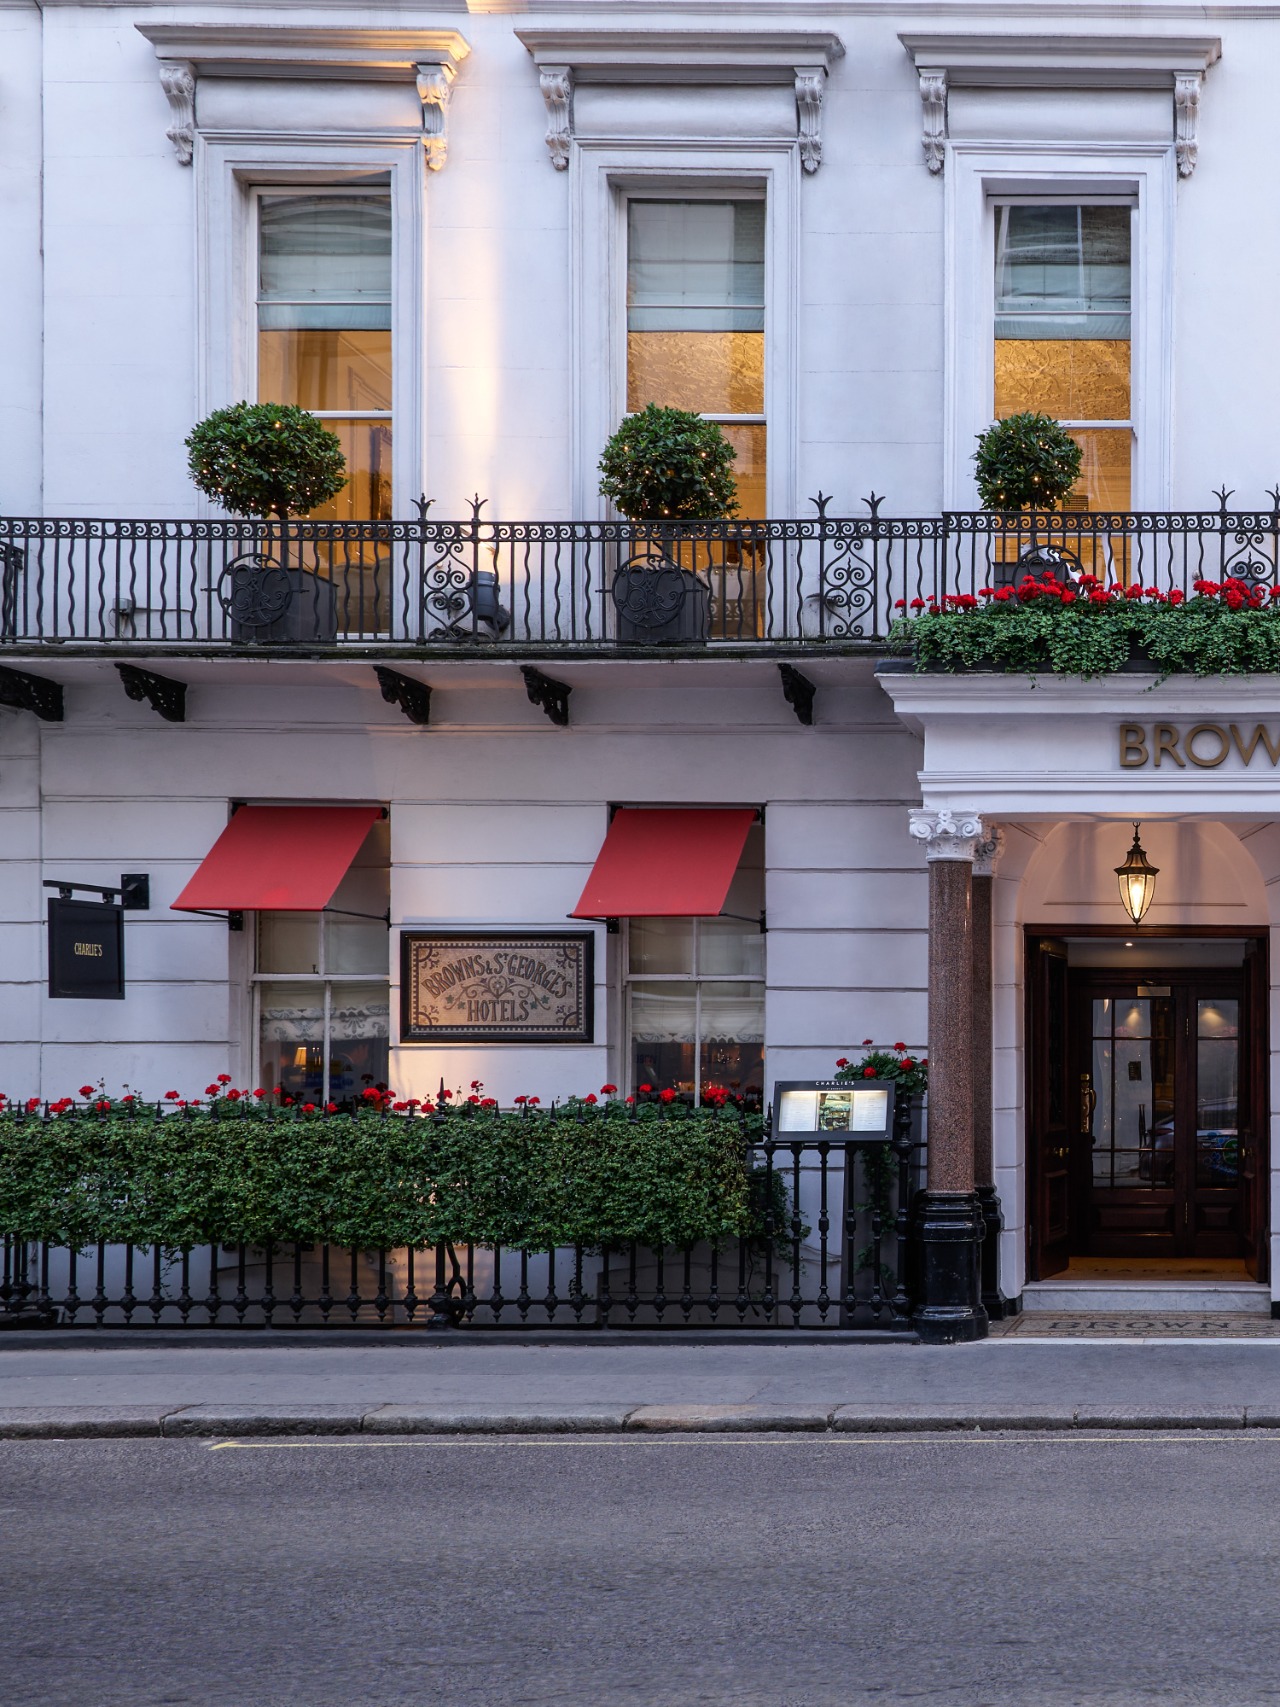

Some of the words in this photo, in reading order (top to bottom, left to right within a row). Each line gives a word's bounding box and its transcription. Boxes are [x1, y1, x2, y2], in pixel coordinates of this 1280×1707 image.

[74, 942, 103, 956] CHARLIE'S
[421, 954, 485, 999] BROWNS
[485, 959, 494, 975] &
[507, 954, 573, 999] GEORGES
[466, 1000, 530, 1022] HOTELS
[1048, 1321, 1275, 1330] BROWNS
